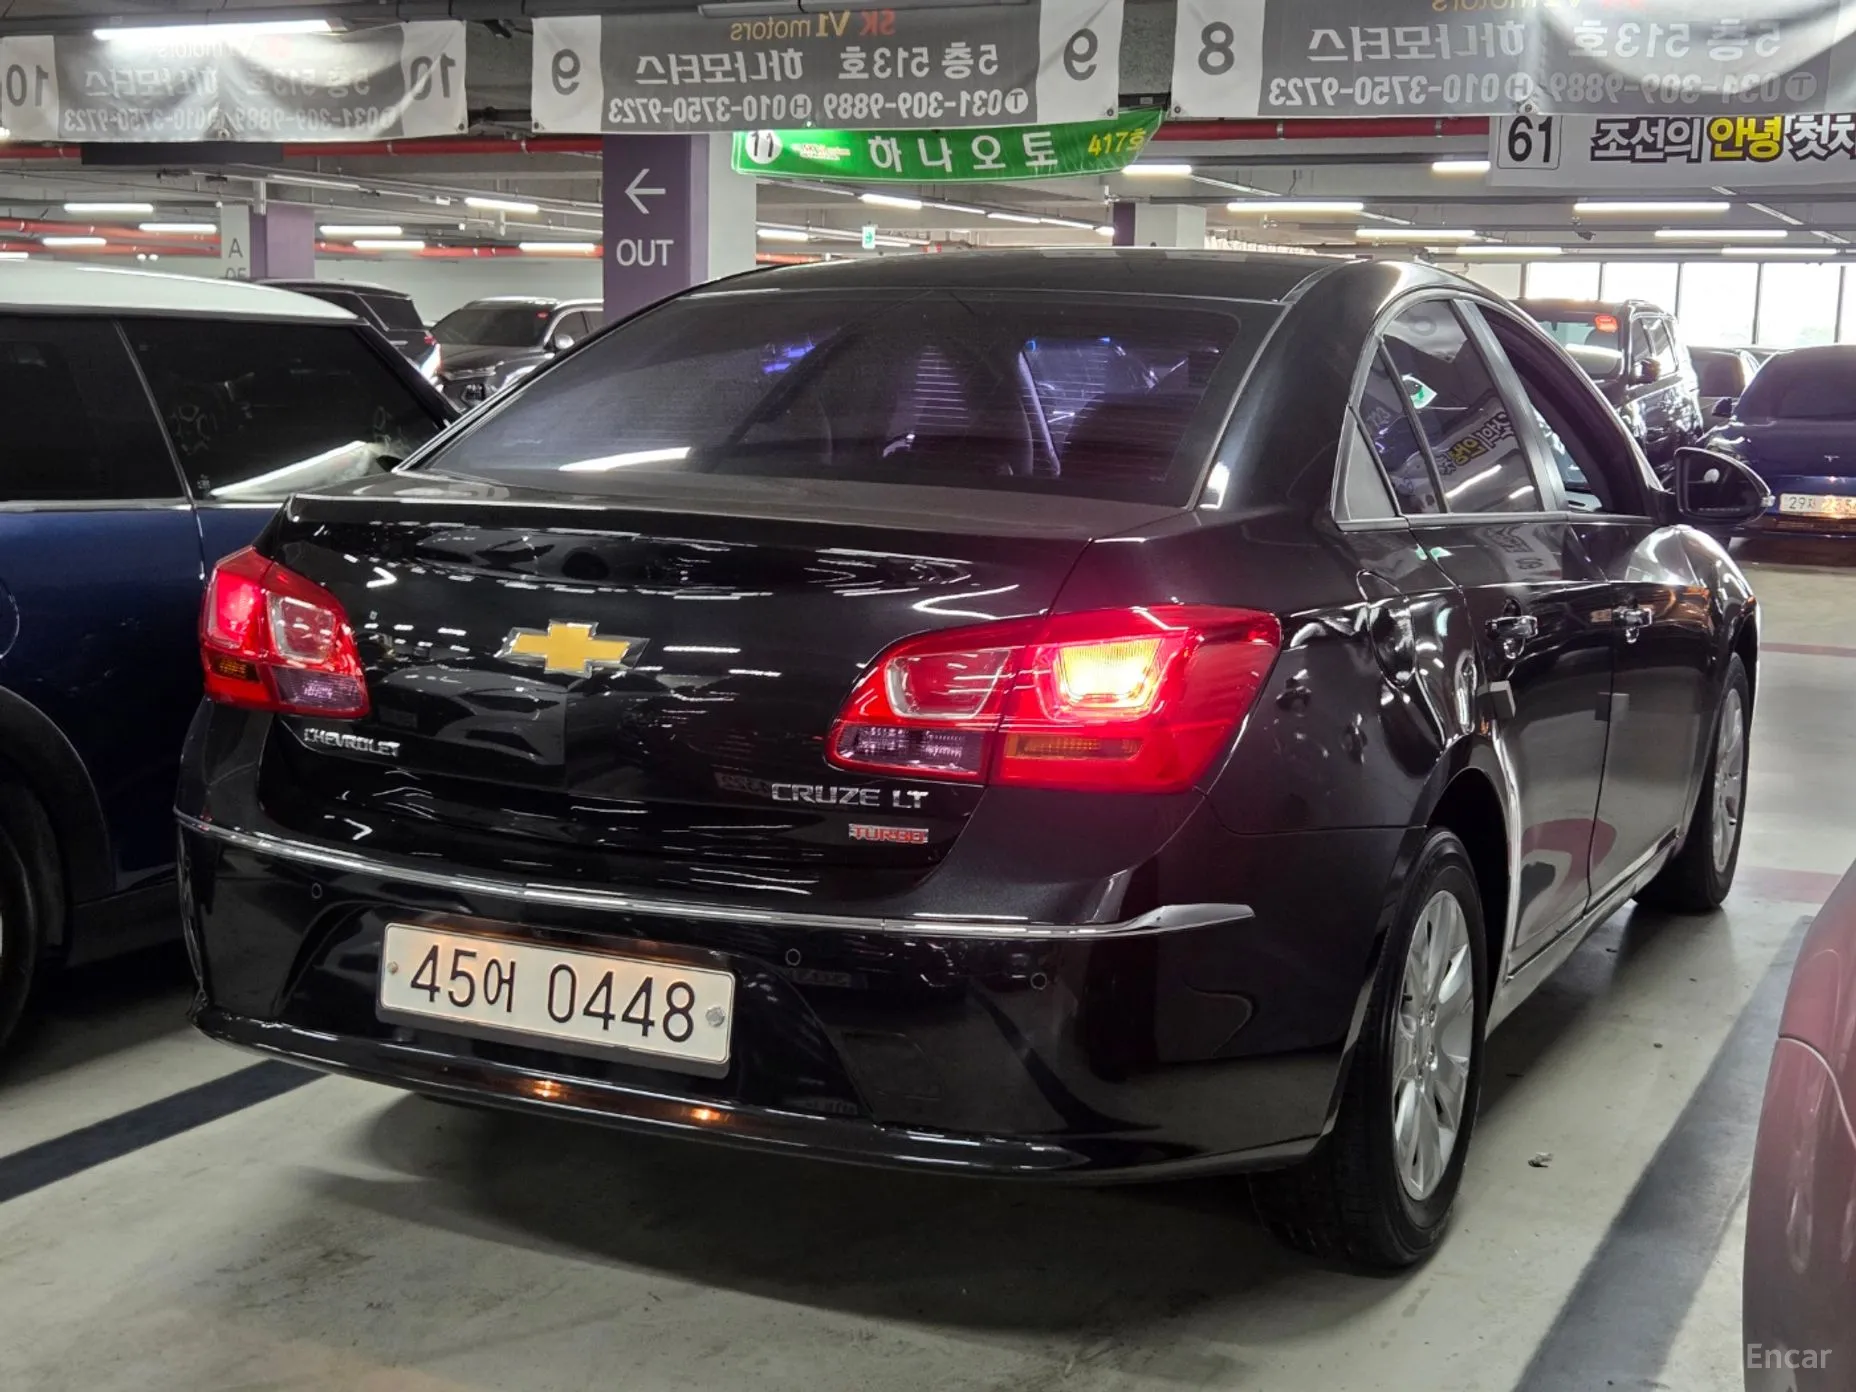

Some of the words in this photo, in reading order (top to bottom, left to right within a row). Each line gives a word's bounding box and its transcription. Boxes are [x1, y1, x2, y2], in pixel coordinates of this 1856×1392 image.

[751, 130, 775, 158] 11
[867, 131, 1058, 173] 하나오토
[1086, 127, 1147, 158] 417호
[1508, 116, 1551, 163] 61
[1593, 116, 1702, 162] 조선의
[1710, 116, 1784, 160] 안녕
[228, 237, 244, 258] A
[616, 238, 675, 267] OUT
[303, 727, 400, 757] CHEVROLET
[771, 783, 881, 808] CRUZE
[892, 789, 929, 809] LT
[848, 823, 929, 845] TURBO
[410, 944, 516, 1013] 45어
[547, 963, 695, 1043] 0448
